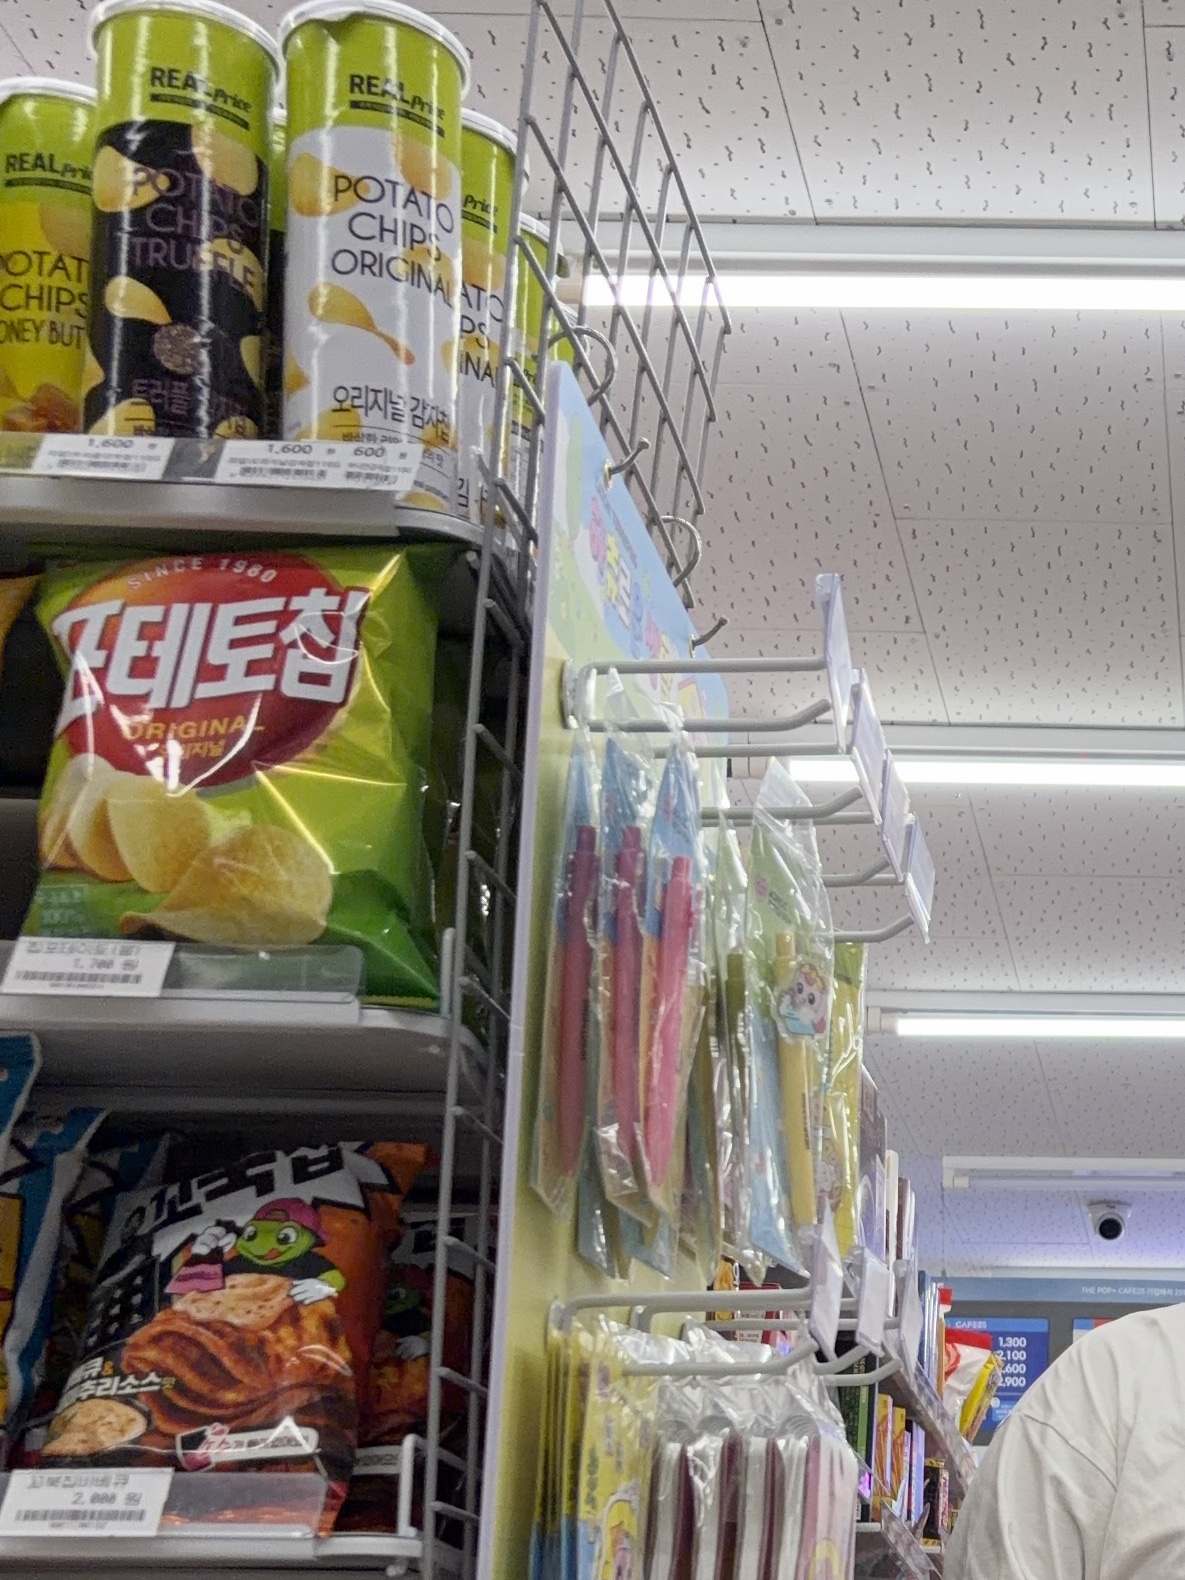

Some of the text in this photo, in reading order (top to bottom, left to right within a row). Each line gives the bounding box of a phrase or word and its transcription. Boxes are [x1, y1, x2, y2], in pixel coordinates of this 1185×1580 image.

[334, 175, 455, 233] POTATO
[348, 211, 442, 262] CHIPS
[0, 251, 90, 283] OTAT
[331, 248, 454, 309] ORIGINAL
[0, 320, 41, 344] ONEY
[331, 385, 405, 423] 오리지널
[266, 443, 386, 458] 1,600 600
[126, 557, 279, 590] SINCE 1980
[121, 715, 265, 743] ORIGINAL
[996, 1349, 1027, 1362] 2,100
[998, 1336, 1027, 1349] 1,300
[997, 1376, 1027, 1389] 2,900
[1000, 1363, 1027, 1376] ,600
[73, 1490, 117, 1506] 2,000
